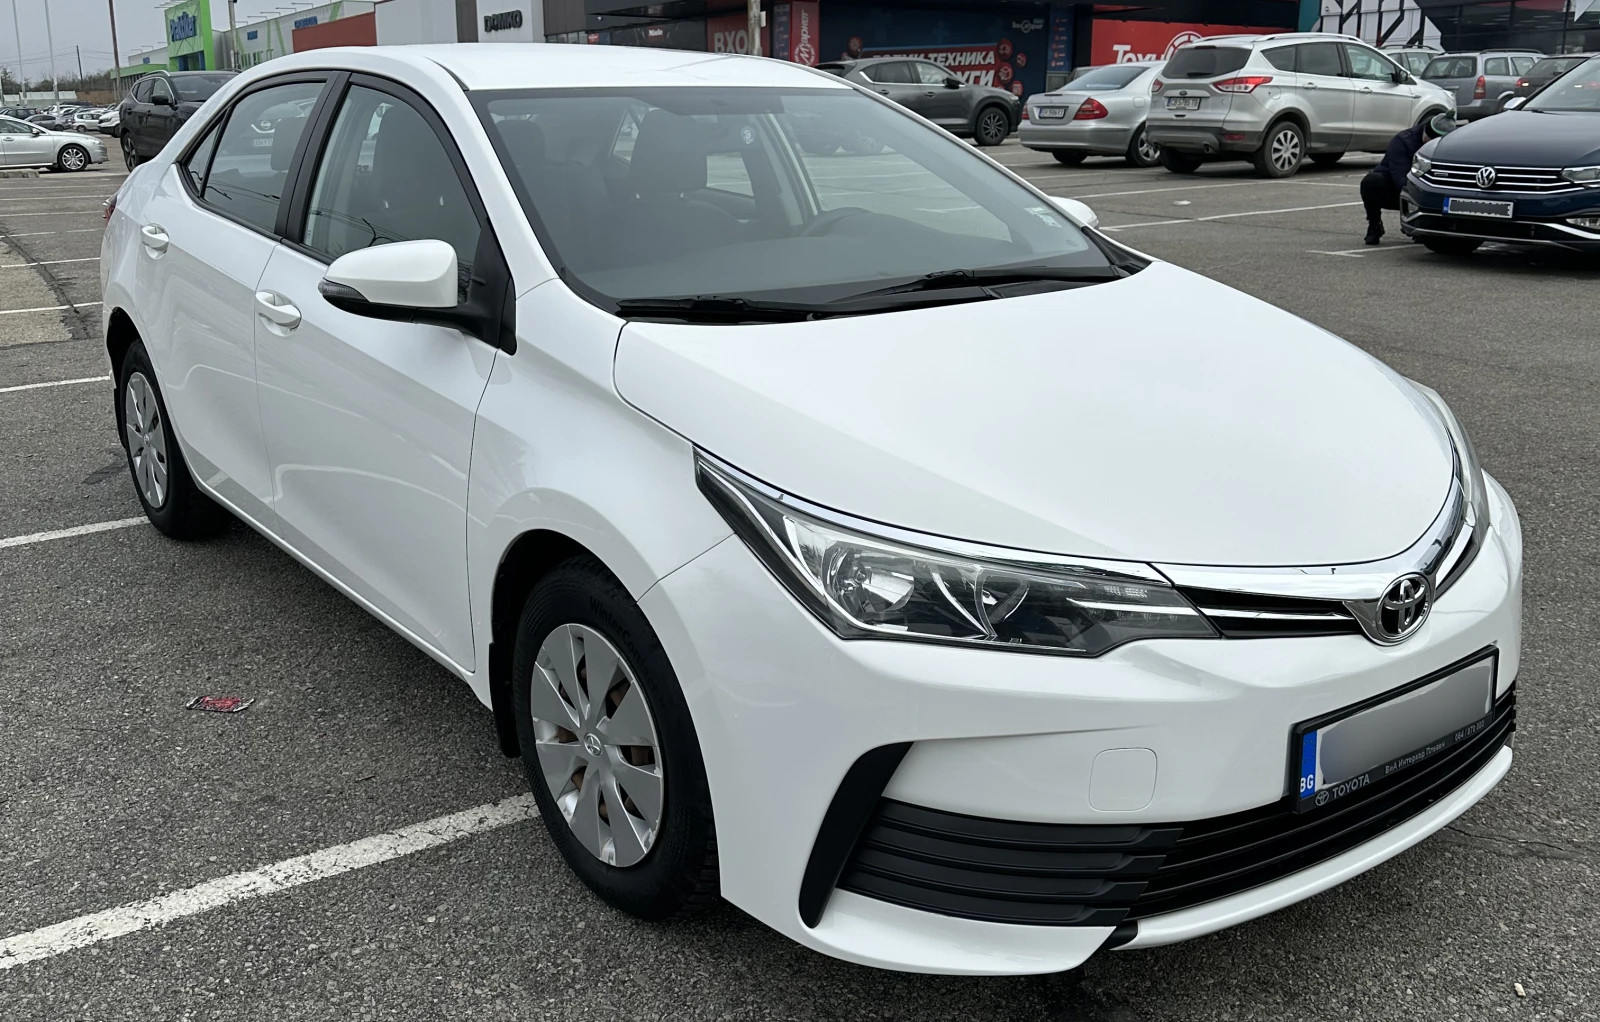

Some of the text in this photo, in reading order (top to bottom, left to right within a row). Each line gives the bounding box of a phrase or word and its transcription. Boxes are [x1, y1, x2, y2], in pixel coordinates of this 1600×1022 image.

[714, 29, 762, 56] ВХО
[928, 50, 996, 67] ТЕХНИКА
[1300, 774, 1314, 793] BG
[1332, 773, 1370, 799] TOYOTA
